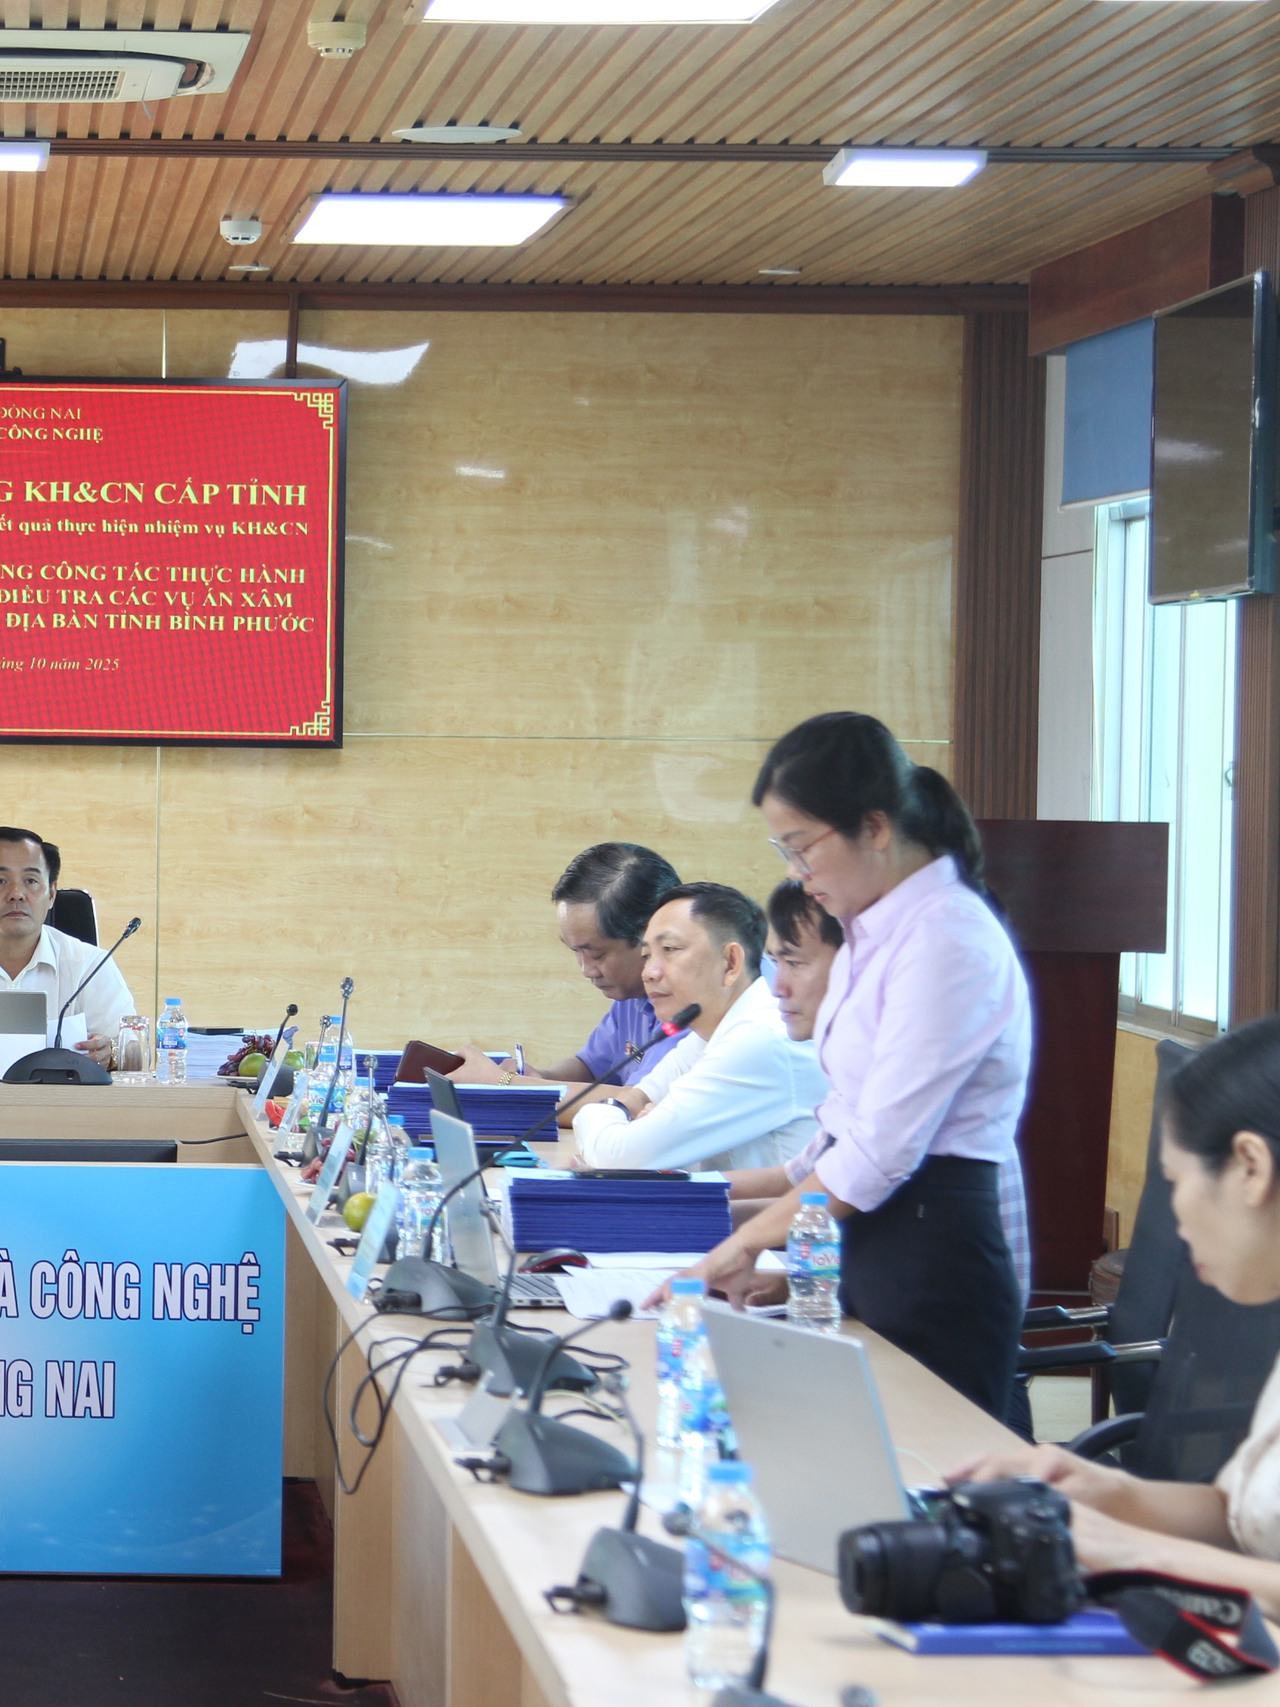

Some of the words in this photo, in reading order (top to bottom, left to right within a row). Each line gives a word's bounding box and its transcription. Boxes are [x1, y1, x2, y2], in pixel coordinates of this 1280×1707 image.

[50, 407, 81, 420] NAI
[52, 427, 104, 443] NGHỆ
[23, 480, 144, 504] KH&CN
[154, 476, 220, 505] CẤP
[227, 478, 306, 506] TỈNH
[19, 519, 51, 535] quả
[57, 518, 96, 536] thực
[102, 519, 138, 536] hiện
[145, 520, 198, 537] nhiệm
[204, 523, 225, 538] vụ
[232, 522, 308, 535] KH&CN
[40, 561, 106, 581] CÔNG
[113, 562, 160, 582] TÁC
[166, 564, 232, 585] THỰC
[239, 564, 306, 584] HÀNH
[57, 590, 104, 605] TRA
[109, 586, 157, 606] CÁC
[164, 591, 194, 611] VỤ
[202, 588, 232, 607] ÁN
[241, 590, 293, 608] XÂM
[6, 613, 46, 632] ĐỊA
[52, 610, 98, 629] BÀN
[104, 610, 161, 630] TỈNH
[170, 611, 224, 631] BÌNH
[233, 613, 314, 632] PHƯỚC
[30, 658, 46, 670] 10
[50, 658, 80, 670] năm
[85, 659, 119, 670] 2025
[30, 1249, 142, 1321] CÔNG
[152, 1251, 261, 1335] NGHỆ
[45, 1359, 116, 1419] NAI
